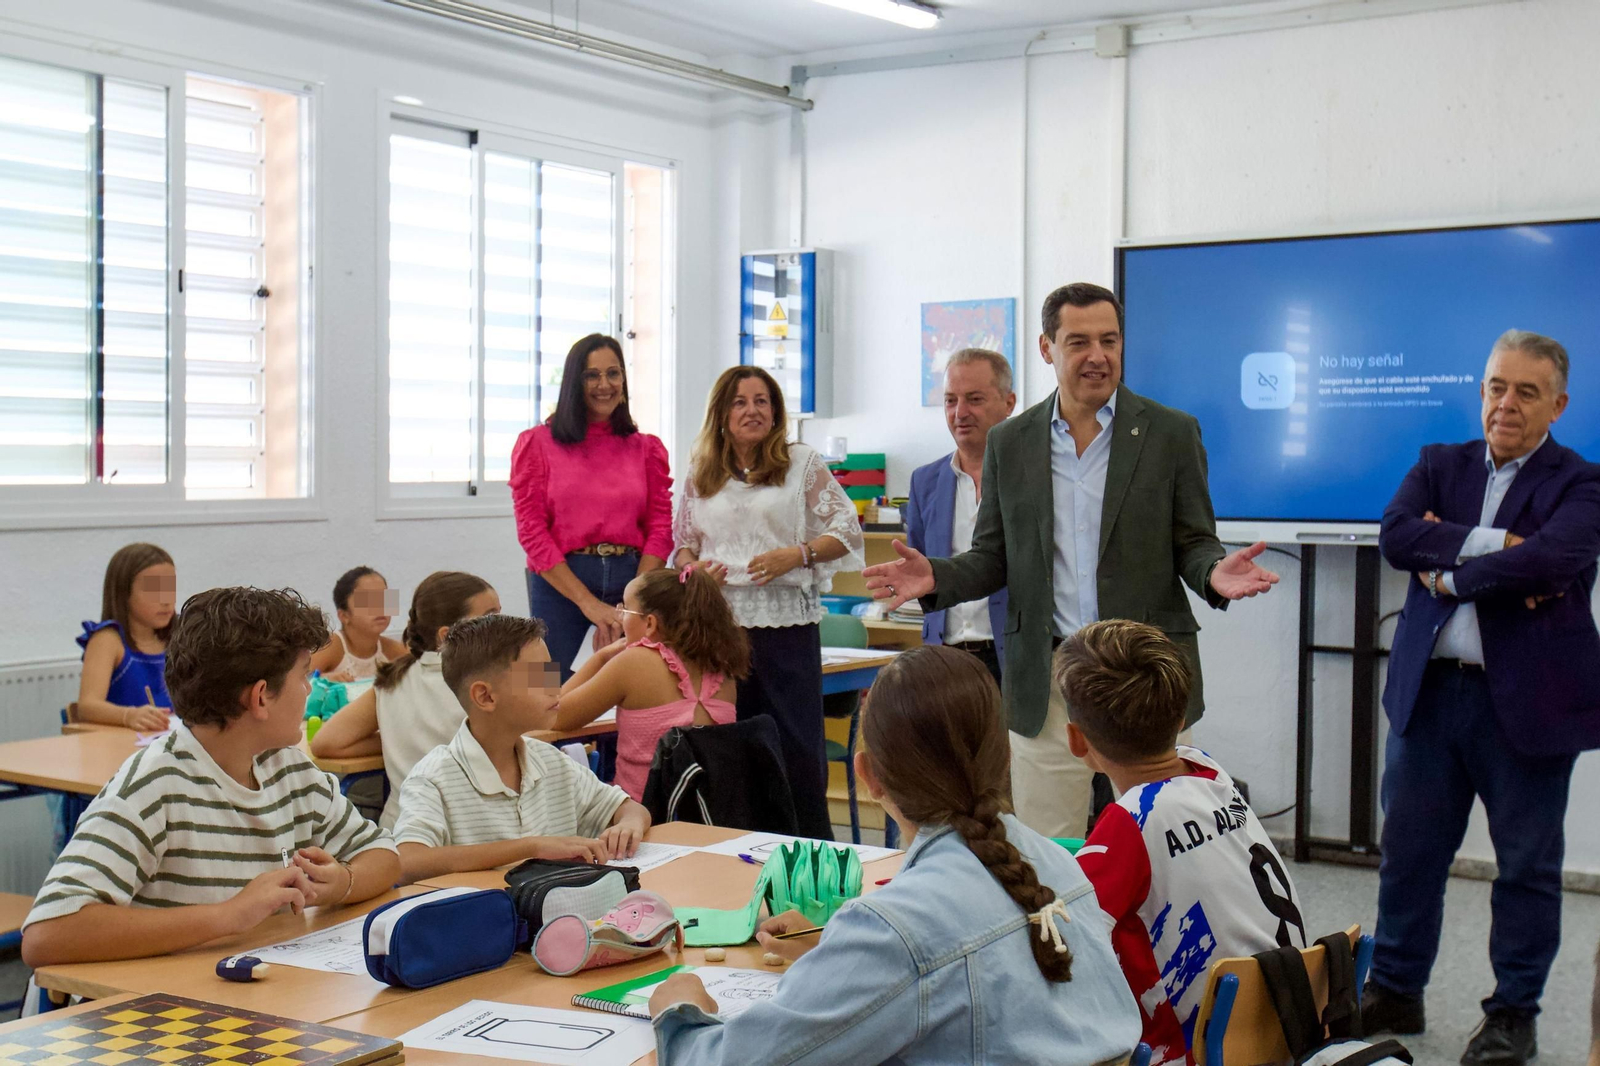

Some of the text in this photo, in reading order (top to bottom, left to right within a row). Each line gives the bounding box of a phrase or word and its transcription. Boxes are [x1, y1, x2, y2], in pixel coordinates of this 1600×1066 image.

[1319, 353, 1404, 371] No hay señal
[1354, 377, 1363, 385] de
[1364, 377, 1377, 386] que
[1378, 376, 1385, 384] el
[1385, 375, 1404, 384] cable
[1421, 374, 1458, 384] enchufado
[1458, 375, 1464, 385] y
[1464, 374, 1475, 383] de
[1318, 387, 1331, 396] que
[1341, 386, 1378, 396] dispositivo
[1394, 384, 1431, 394] encendido
[1164, 819, 1213, 859] A.D.
